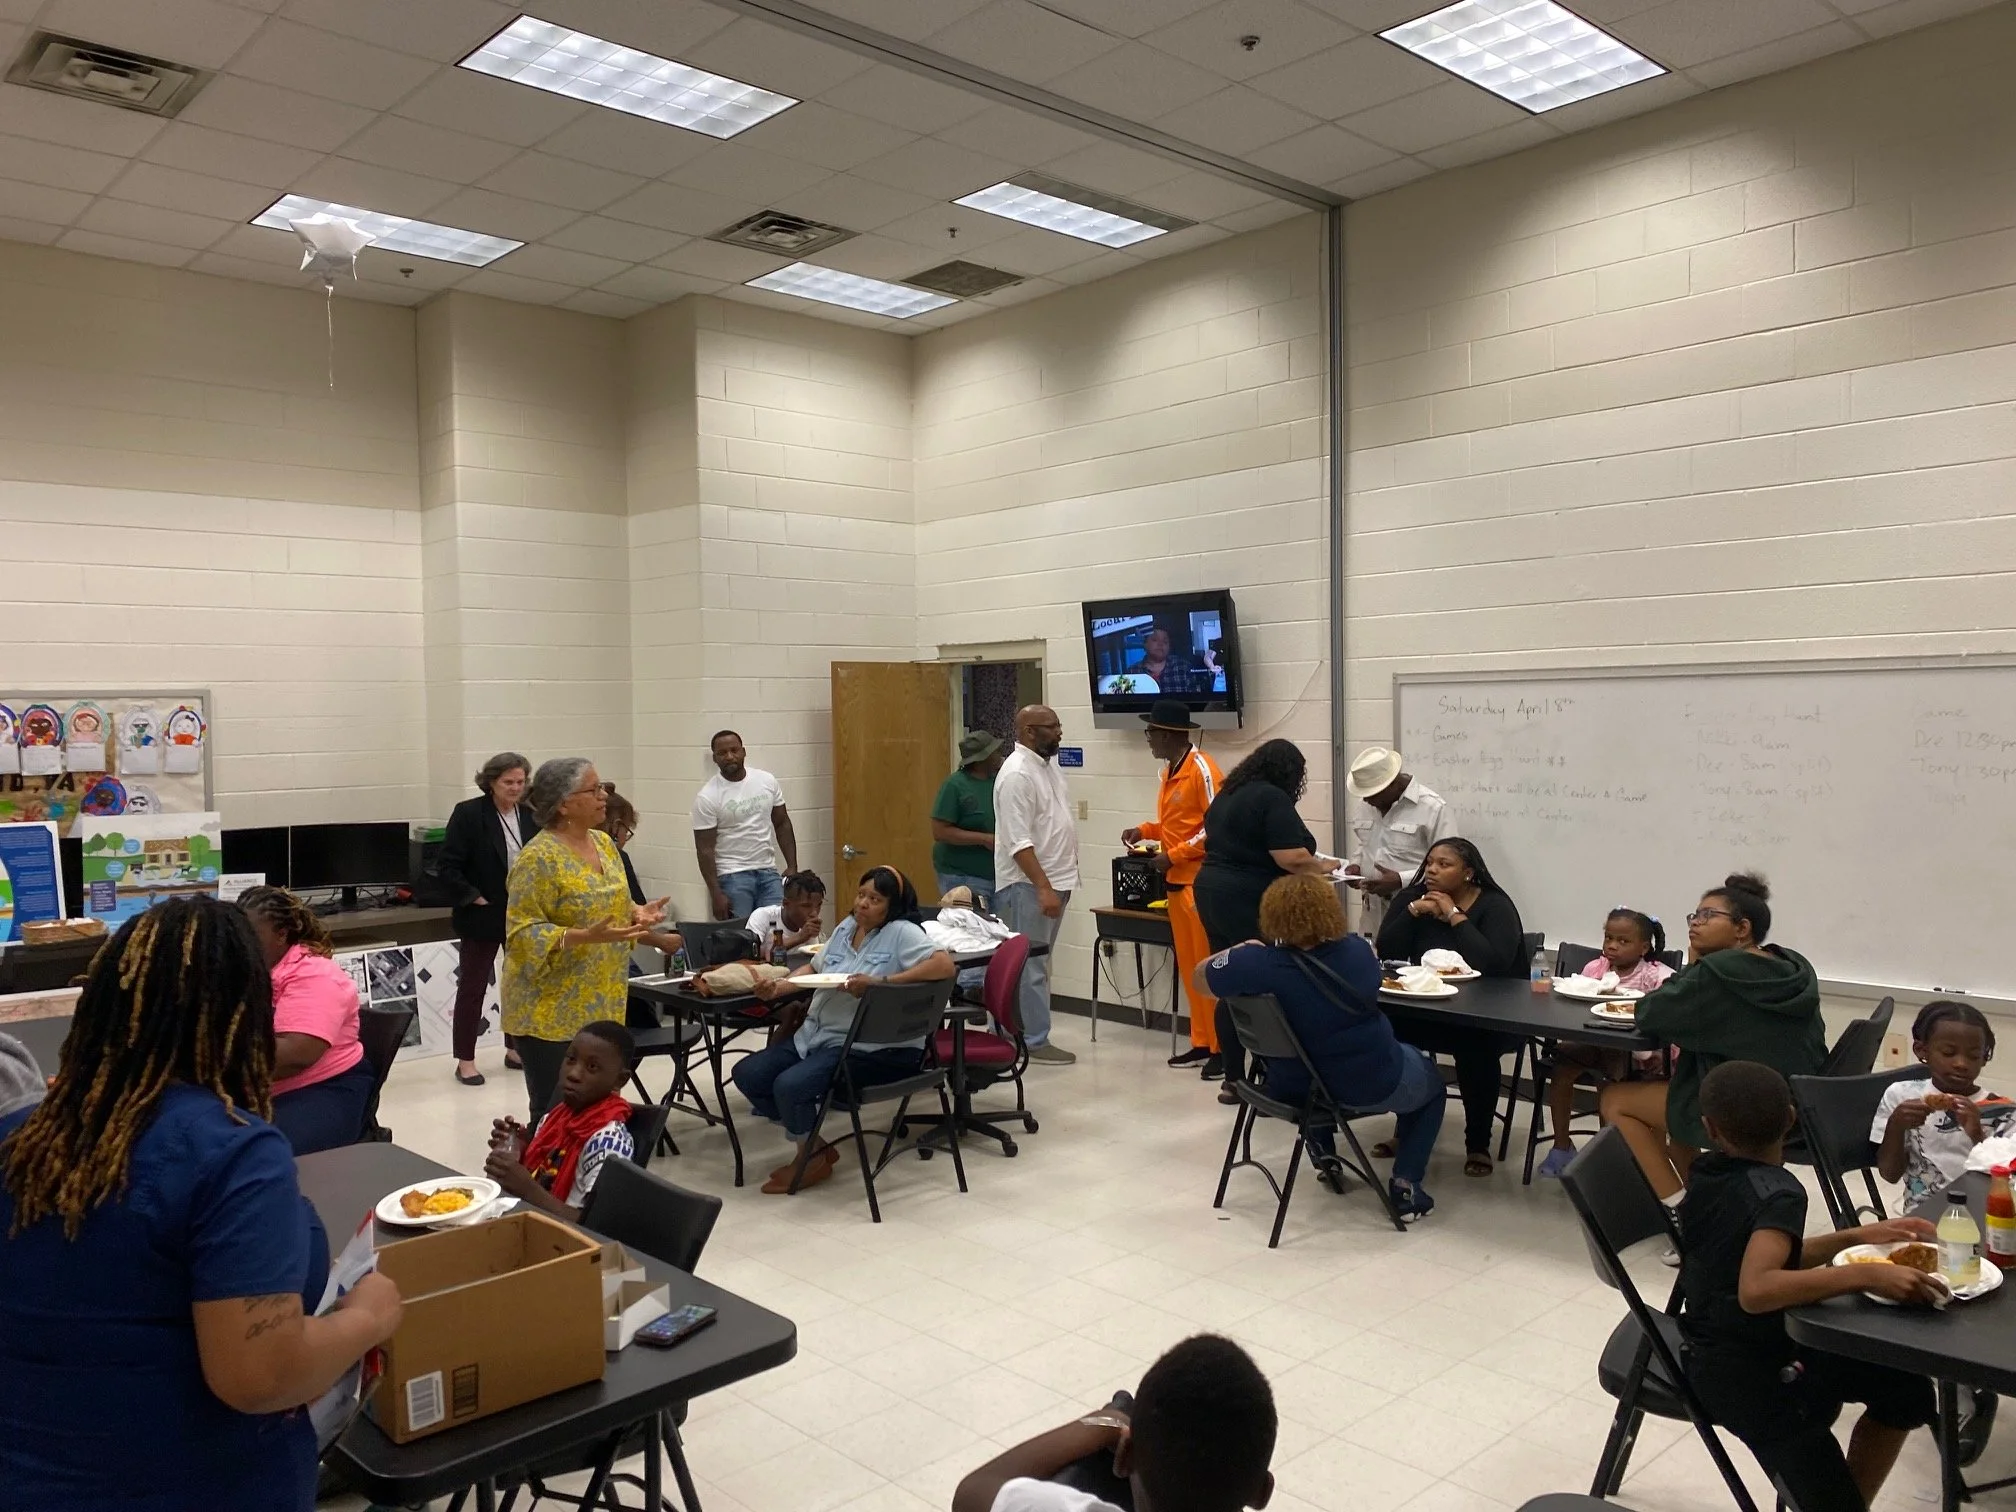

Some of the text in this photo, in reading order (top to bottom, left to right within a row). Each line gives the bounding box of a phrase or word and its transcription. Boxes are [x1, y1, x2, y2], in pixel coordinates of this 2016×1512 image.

[1438, 695, 1506, 723] Saturday
[1517, 697, 1549, 720] April
[1432, 725, 1469, 743] Games
[1432, 751, 1472, 768] Easter
[1479, 750, 1504, 772] Egg
[1506, 782, 1523, 794] will
